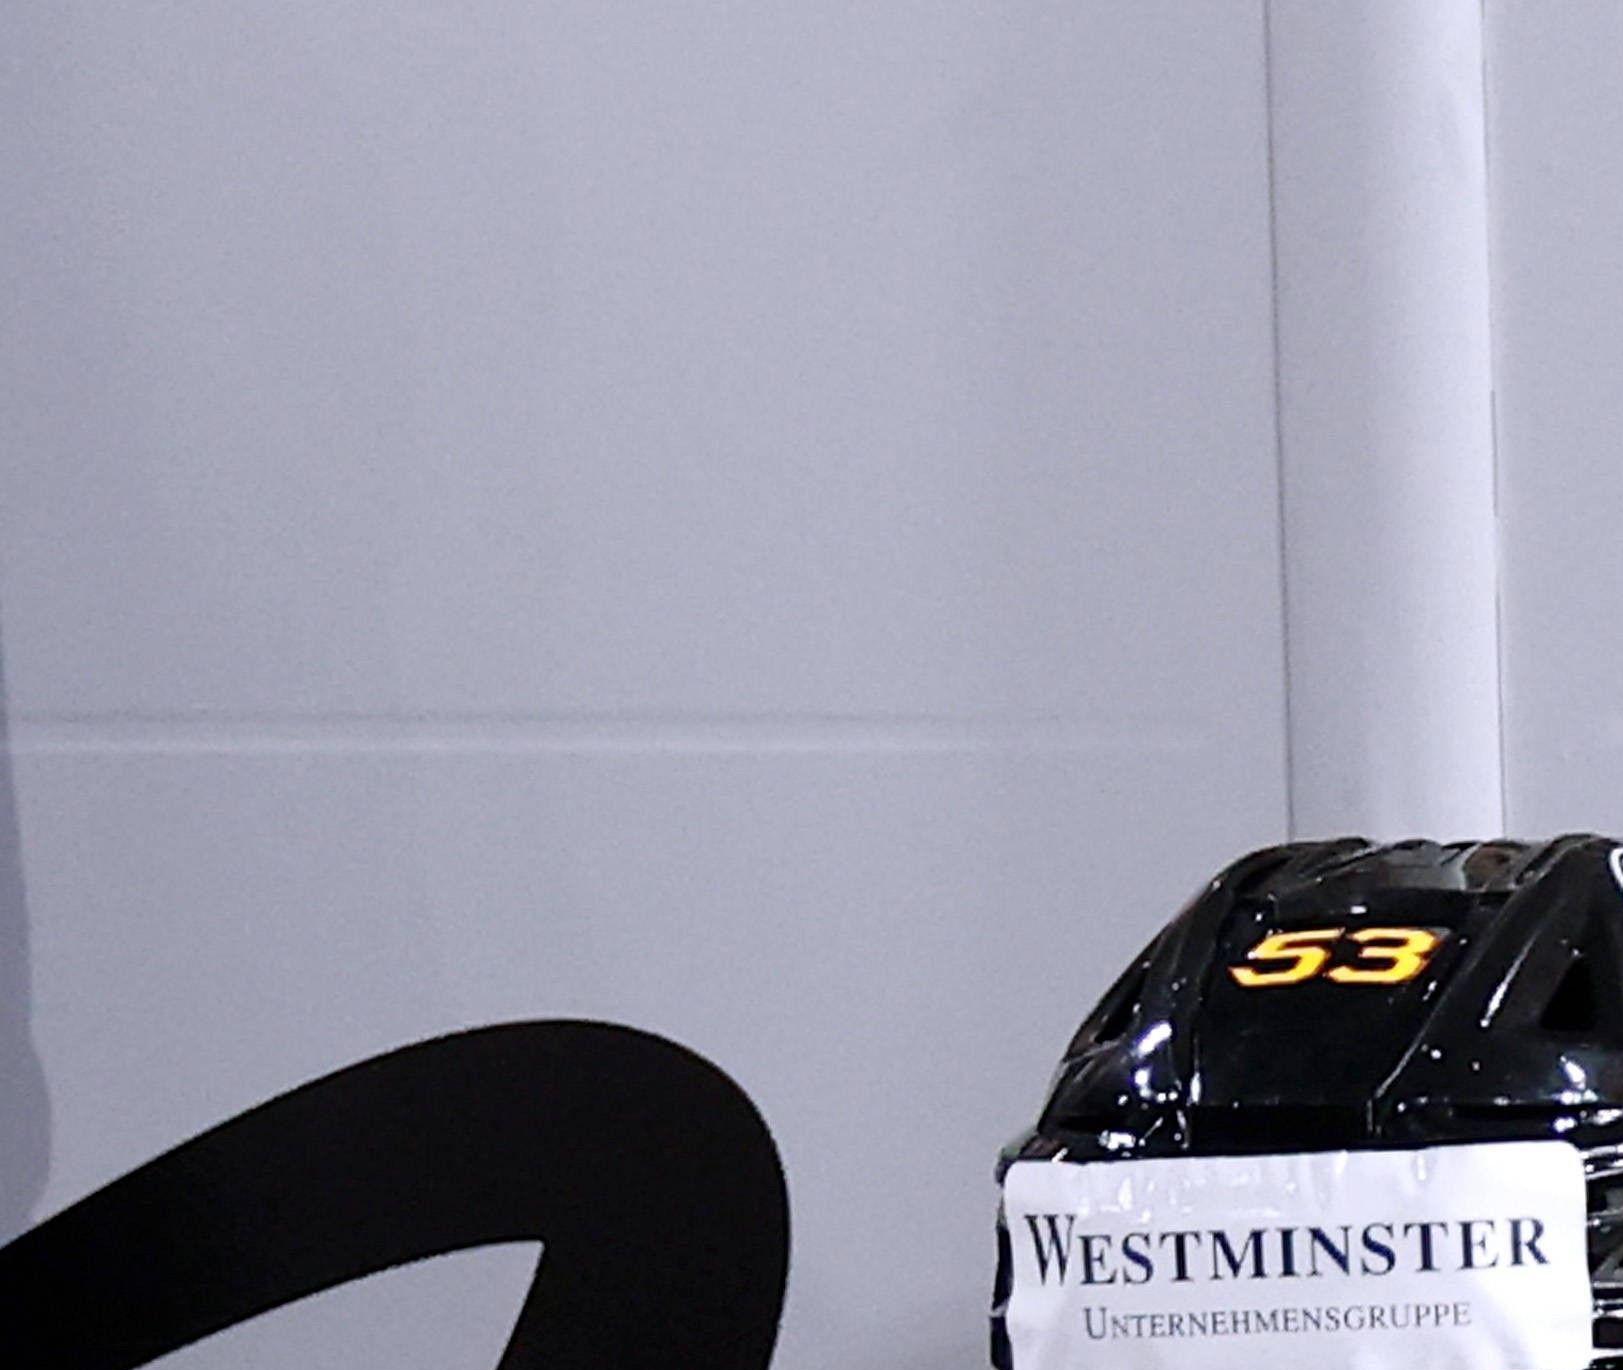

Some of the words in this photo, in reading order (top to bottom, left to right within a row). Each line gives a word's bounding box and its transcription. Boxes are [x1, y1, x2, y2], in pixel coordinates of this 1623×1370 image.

[1227, 926, 1443, 986] 53
[1024, 1213, 1551, 1288] WESTMINSTER
[1083, 1301, 1472, 1342] UNTERNEHMENSGRUPPE
